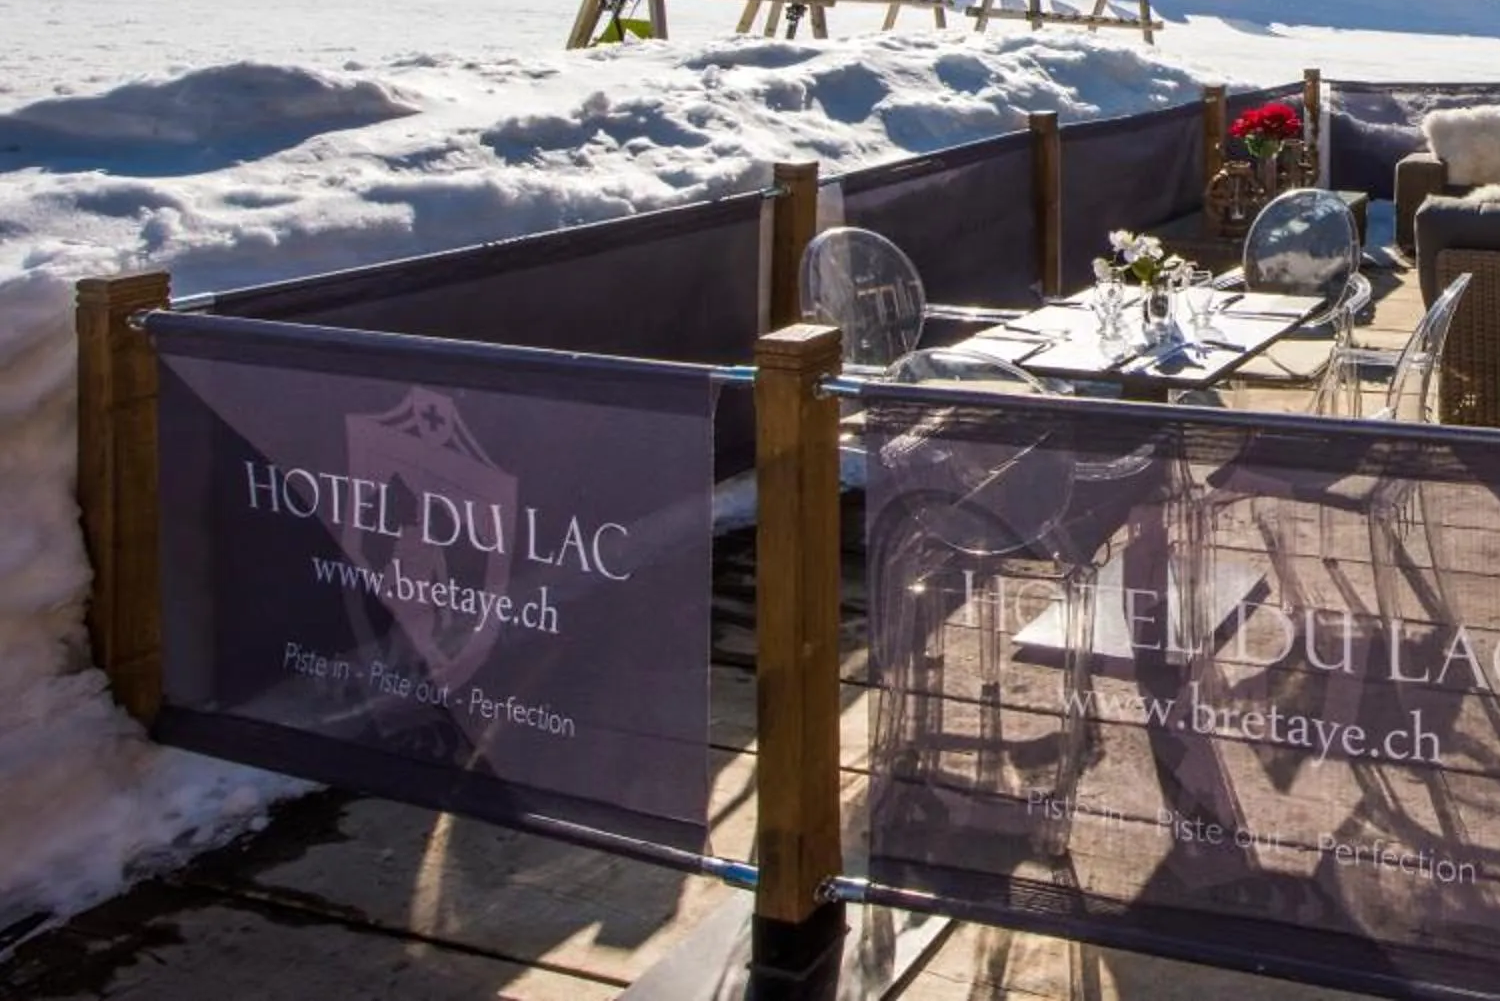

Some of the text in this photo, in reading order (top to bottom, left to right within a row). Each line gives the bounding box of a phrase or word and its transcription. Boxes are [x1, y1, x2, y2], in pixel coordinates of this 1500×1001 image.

[244, 460, 632, 582] HOTEL DU LAC
[312, 556, 560, 634] www.bretaye.ch
[1235, 599, 1356, 675] DU
[283, 641, 326, 678] Piste
[331, 658, 350, 680] in
[369, 659, 411, 698] Piste
[415, 681, 450, 706] out
[469, 687, 576, 737] Perfection
[1060, 680, 1443, 768] www.bretaye.ch
[1157, 806, 1224, 845] Piste
[1317, 832, 1477, 884] Perfection
